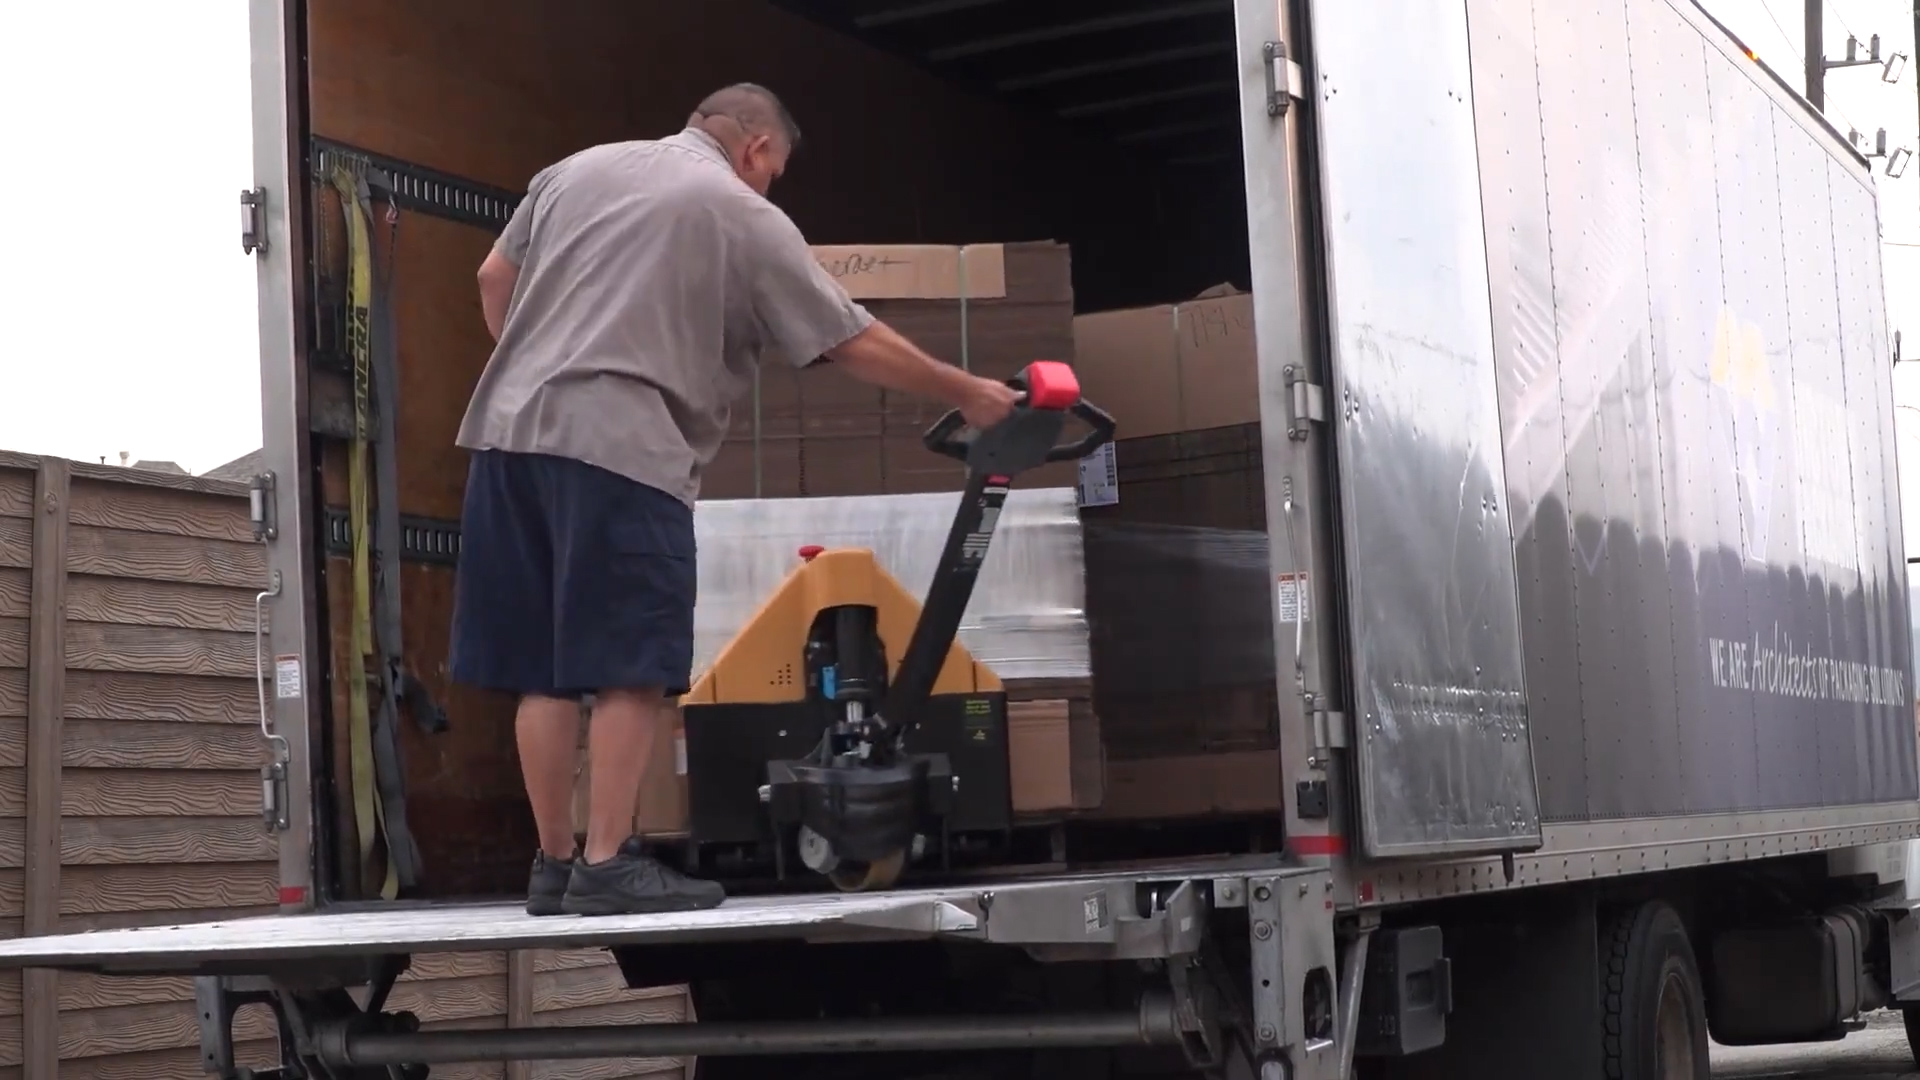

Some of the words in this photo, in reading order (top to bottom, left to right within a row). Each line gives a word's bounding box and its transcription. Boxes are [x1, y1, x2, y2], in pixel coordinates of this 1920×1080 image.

[1709, 637, 1727, 687] WE
[1728, 641, 1749, 689] ARE
[1752, 620, 1817, 699] Architects
[1819, 657, 1828, 699] OF
